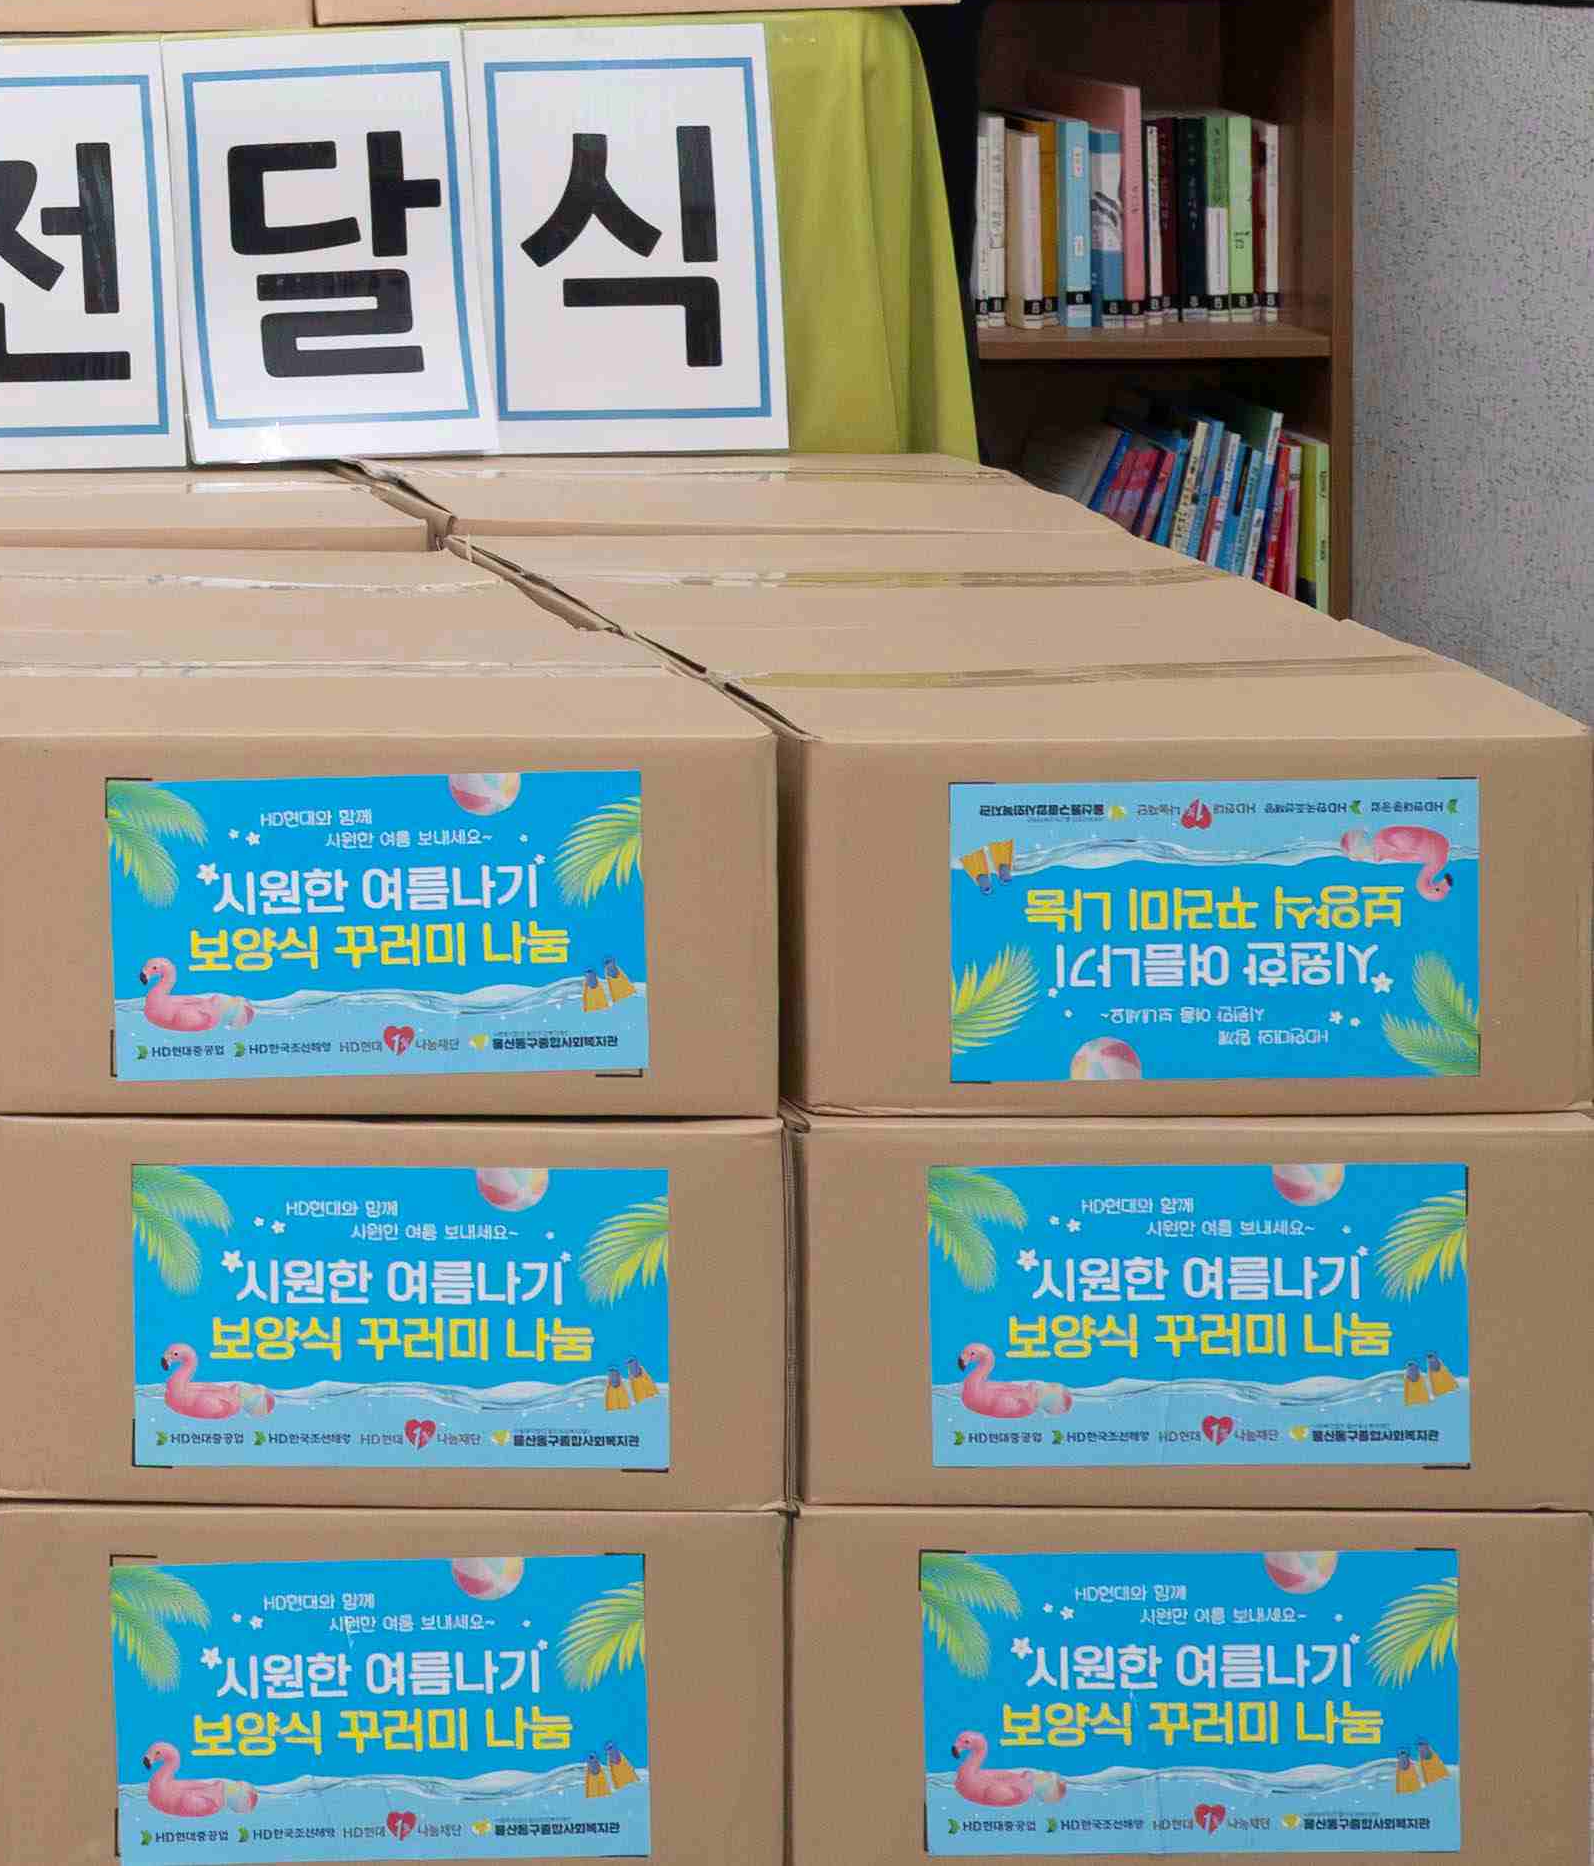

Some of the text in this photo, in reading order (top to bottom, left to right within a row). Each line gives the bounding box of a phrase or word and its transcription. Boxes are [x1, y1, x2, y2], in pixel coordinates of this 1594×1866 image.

[1022, 883, 1404, 933] 보양식 꾸러미 나눔
[1054, 939, 1379, 990] 시원한 여름나기
